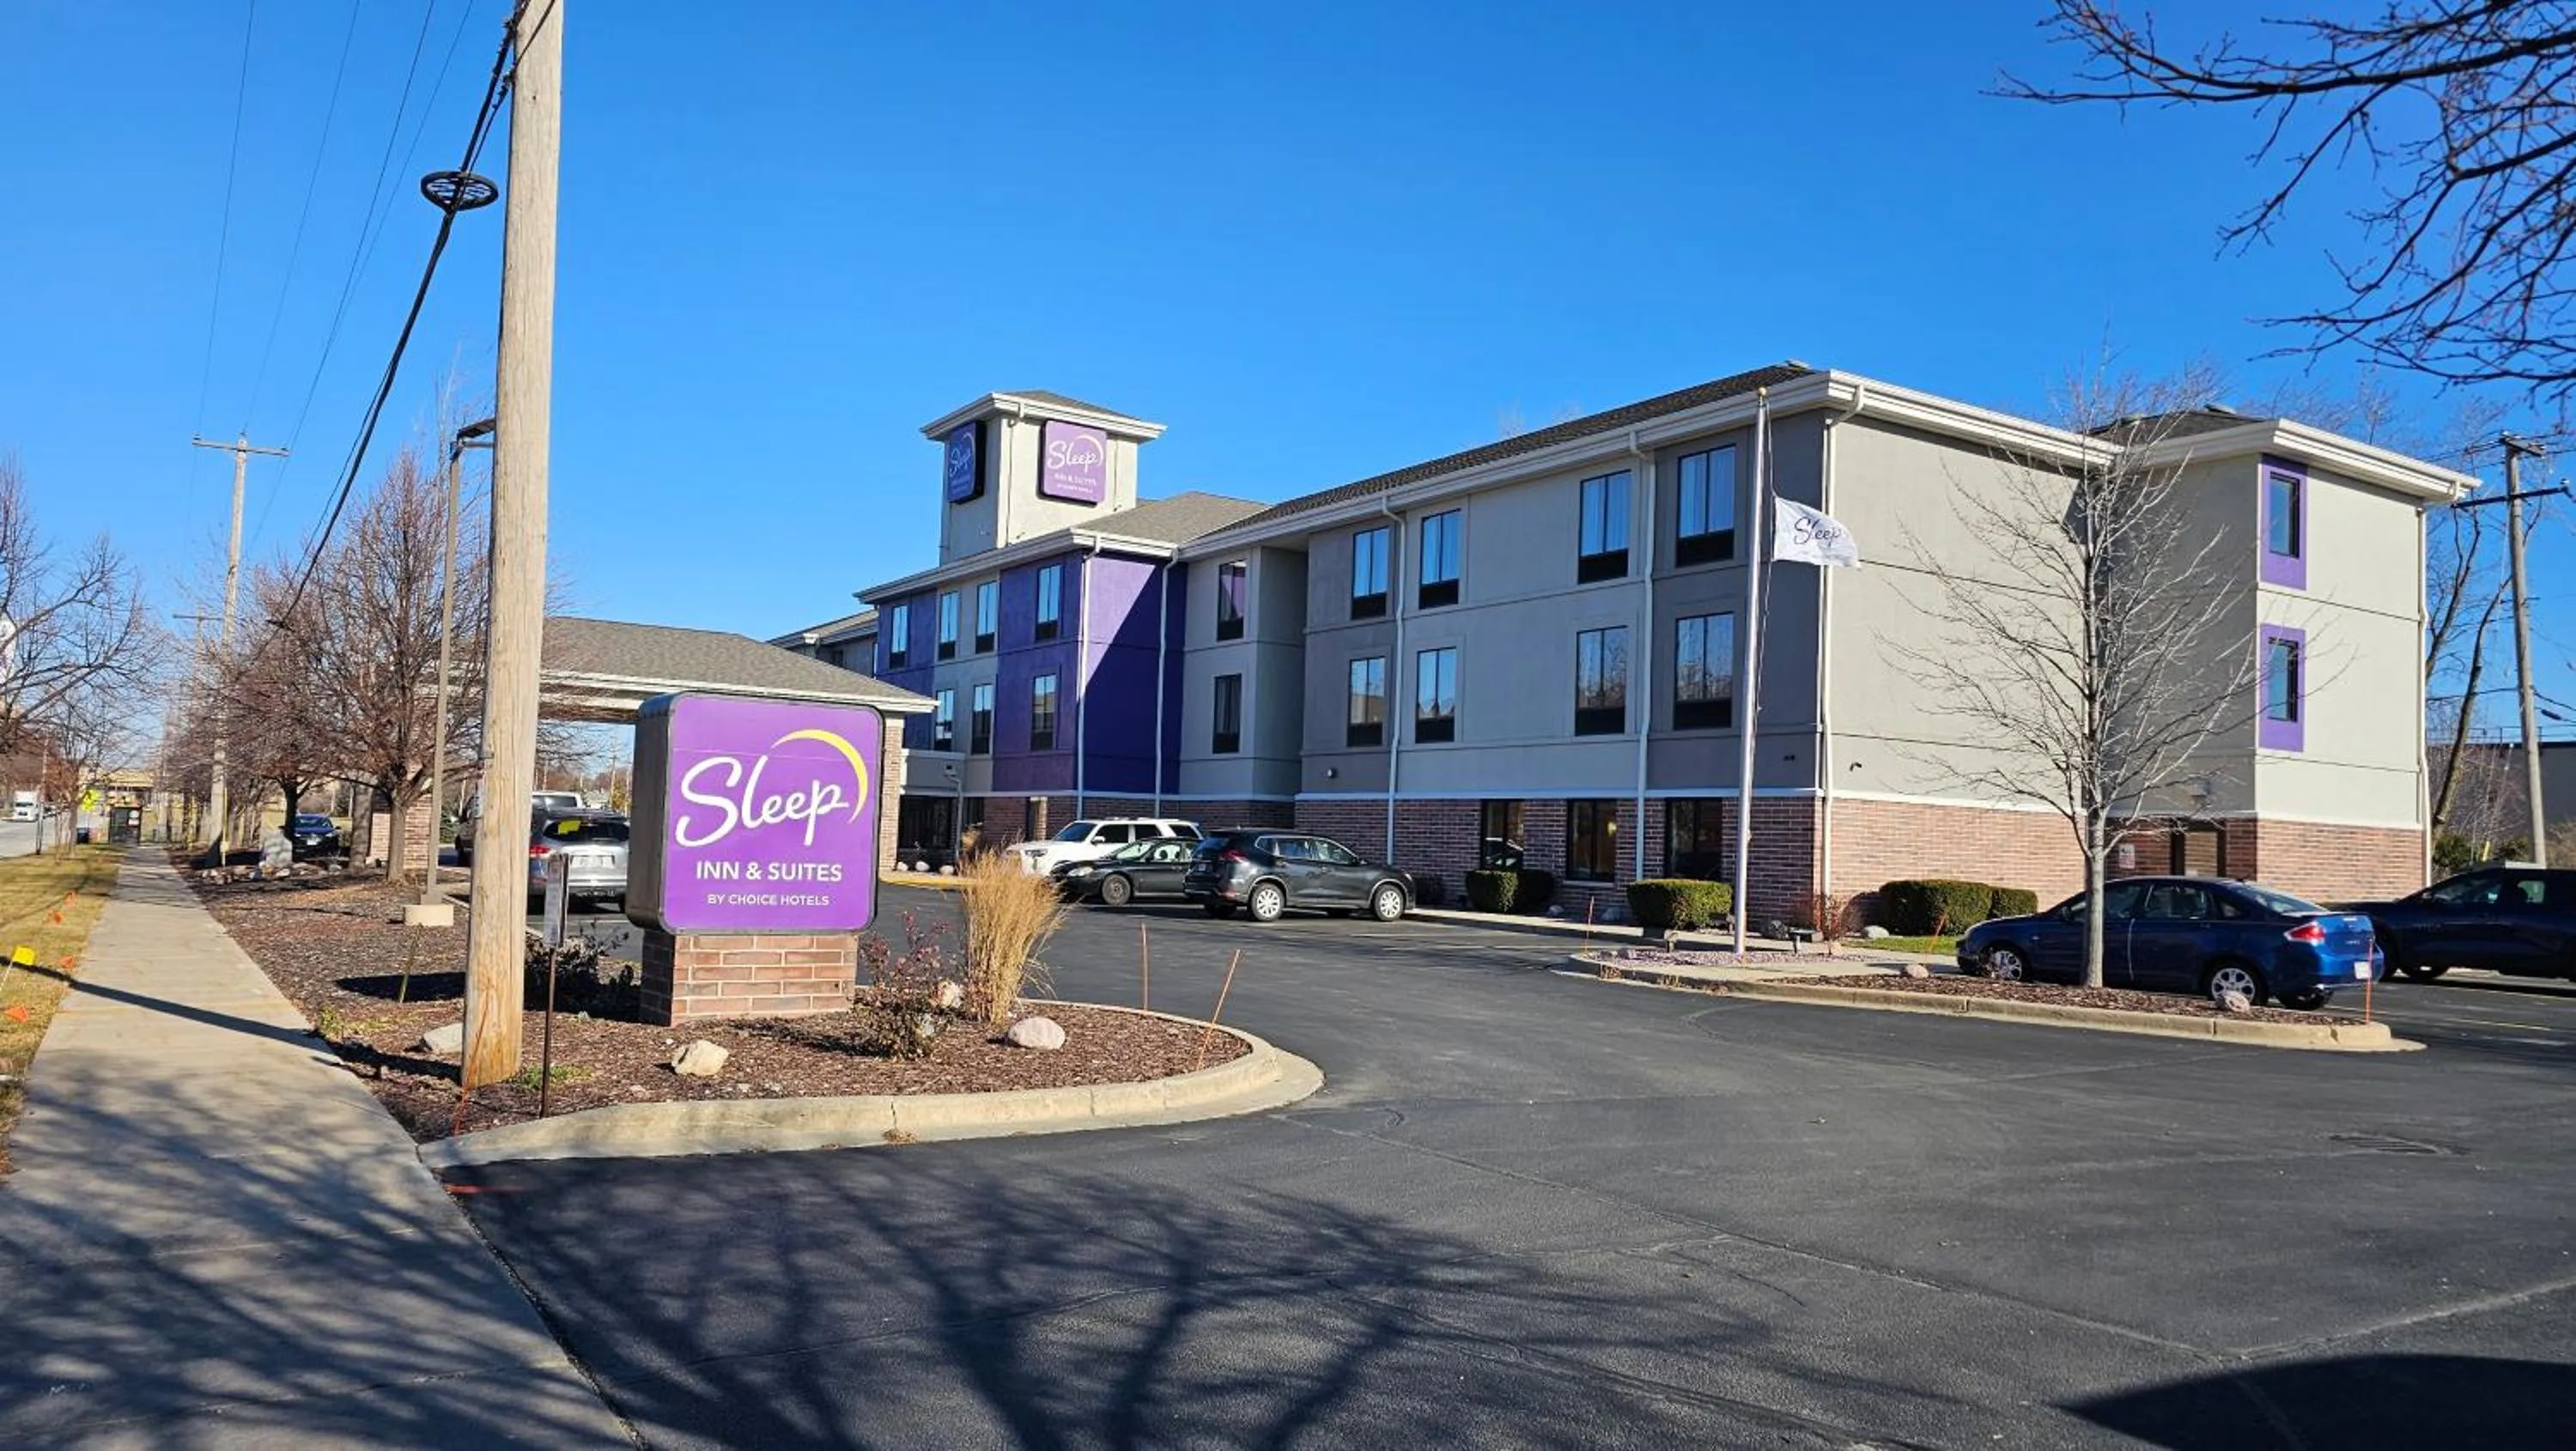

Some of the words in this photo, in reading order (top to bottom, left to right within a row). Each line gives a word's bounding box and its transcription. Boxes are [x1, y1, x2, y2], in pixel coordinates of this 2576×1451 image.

[1048, 440, 1098, 473] Sleep
[1794, 516, 1842, 548] Sleep
[675, 755, 850, 847] Sleep
[696, 861, 739, 880] INN
[745, 862, 762, 880] &
[768, 863, 842, 882] SUITES
[708, 894, 726, 904] BY
[729, 894, 777, 905] CHOICE
[781, 895, 829, 906] HOTELS
